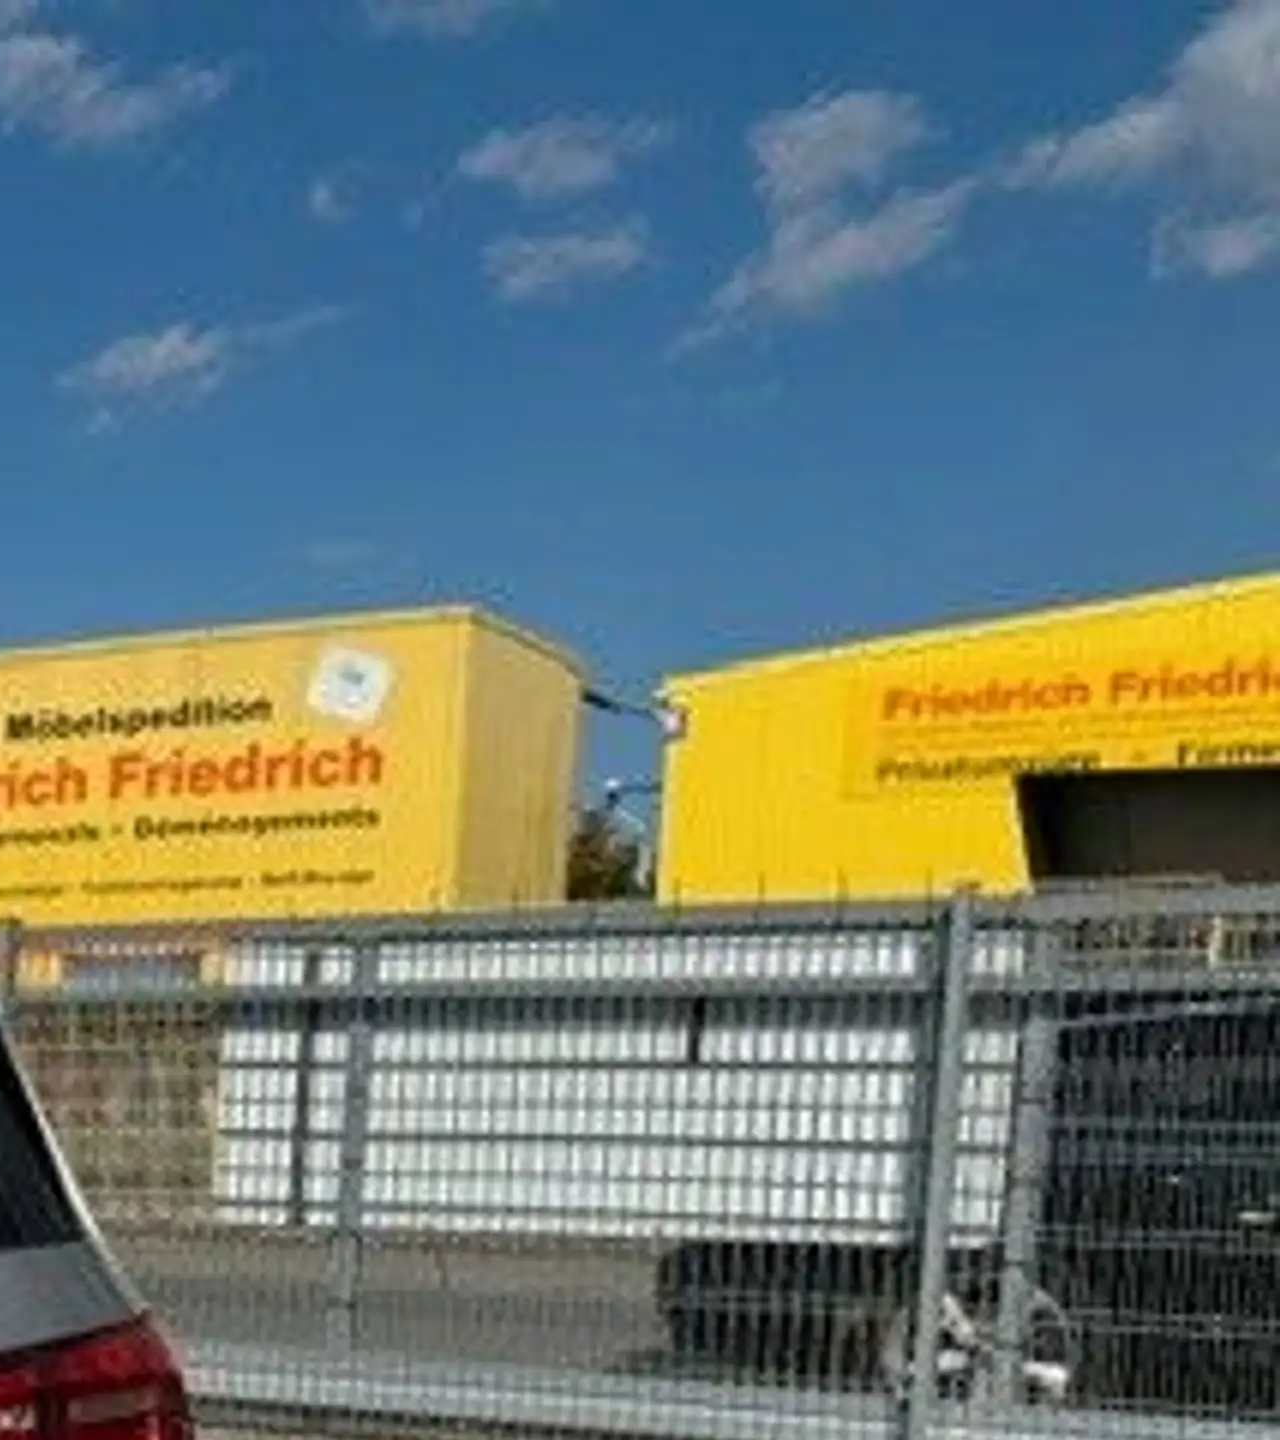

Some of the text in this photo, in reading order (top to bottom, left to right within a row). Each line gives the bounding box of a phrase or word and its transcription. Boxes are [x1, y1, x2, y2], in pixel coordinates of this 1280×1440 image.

[3, 697, 274, 740] Möbelspedition
[883, 674, 1093, 721] Friedrich
[108, 736, 384, 801] Friedrich
